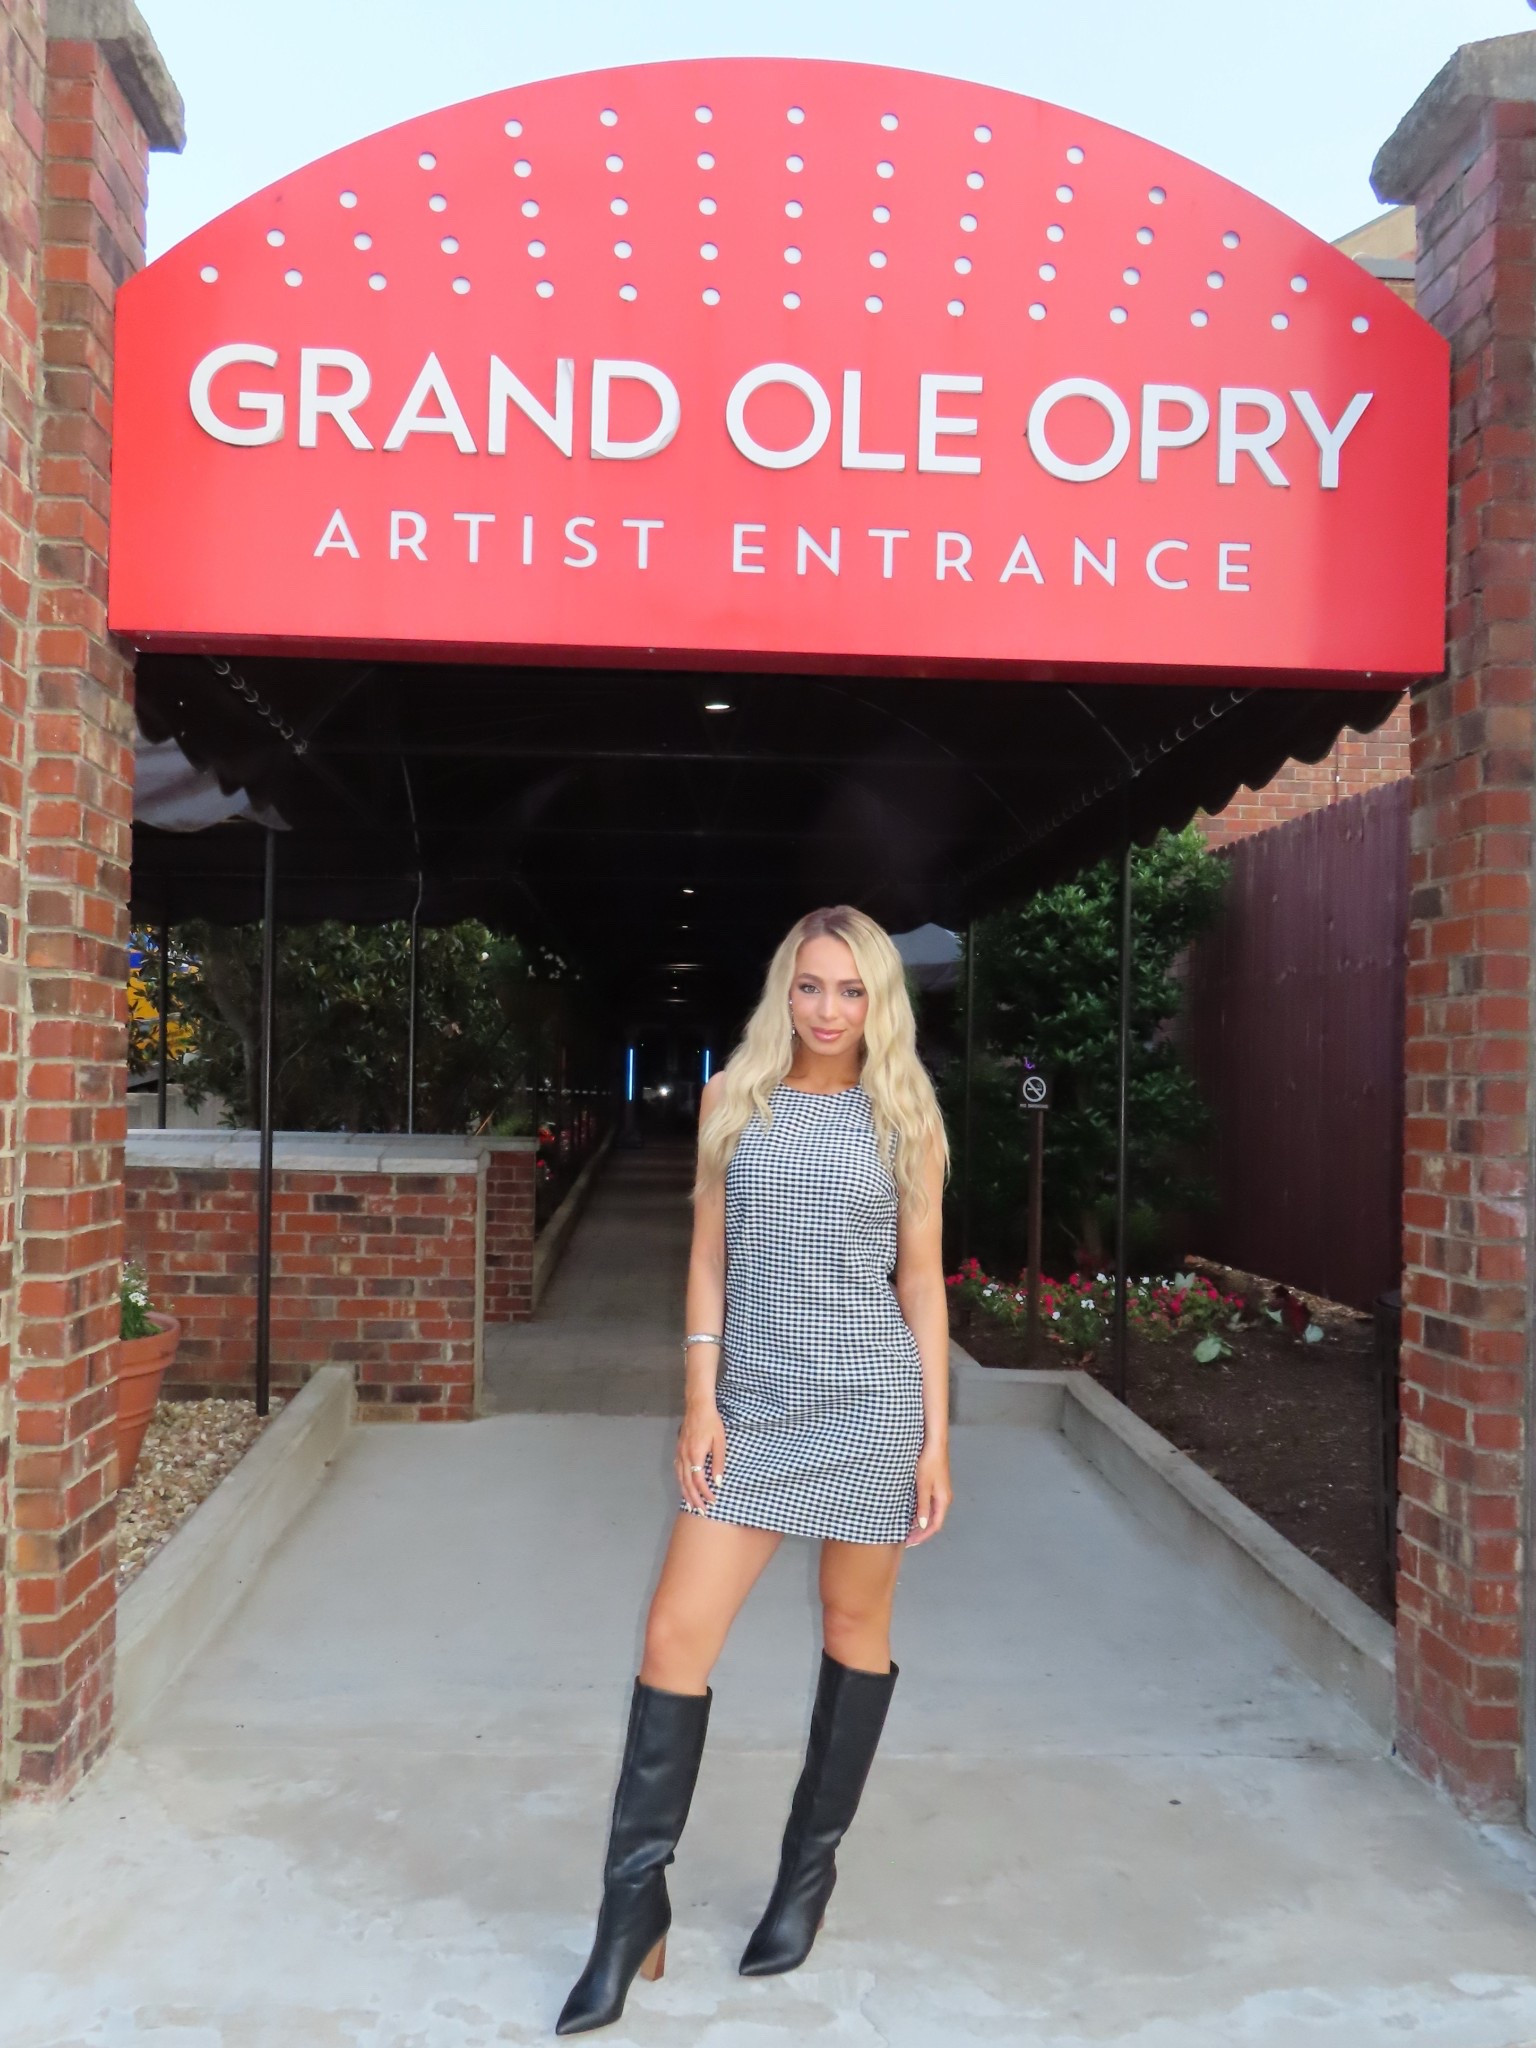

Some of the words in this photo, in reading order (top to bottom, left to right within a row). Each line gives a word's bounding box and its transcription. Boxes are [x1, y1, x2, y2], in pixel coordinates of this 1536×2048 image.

[188, 342, 683, 460] GRAND
[725, 361, 985, 475] OLE
[1026, 375, 1375, 489] OPRY
[313, 508, 665, 570] ARTIST
[732, 523, 1251, 593] ENTRANCE
